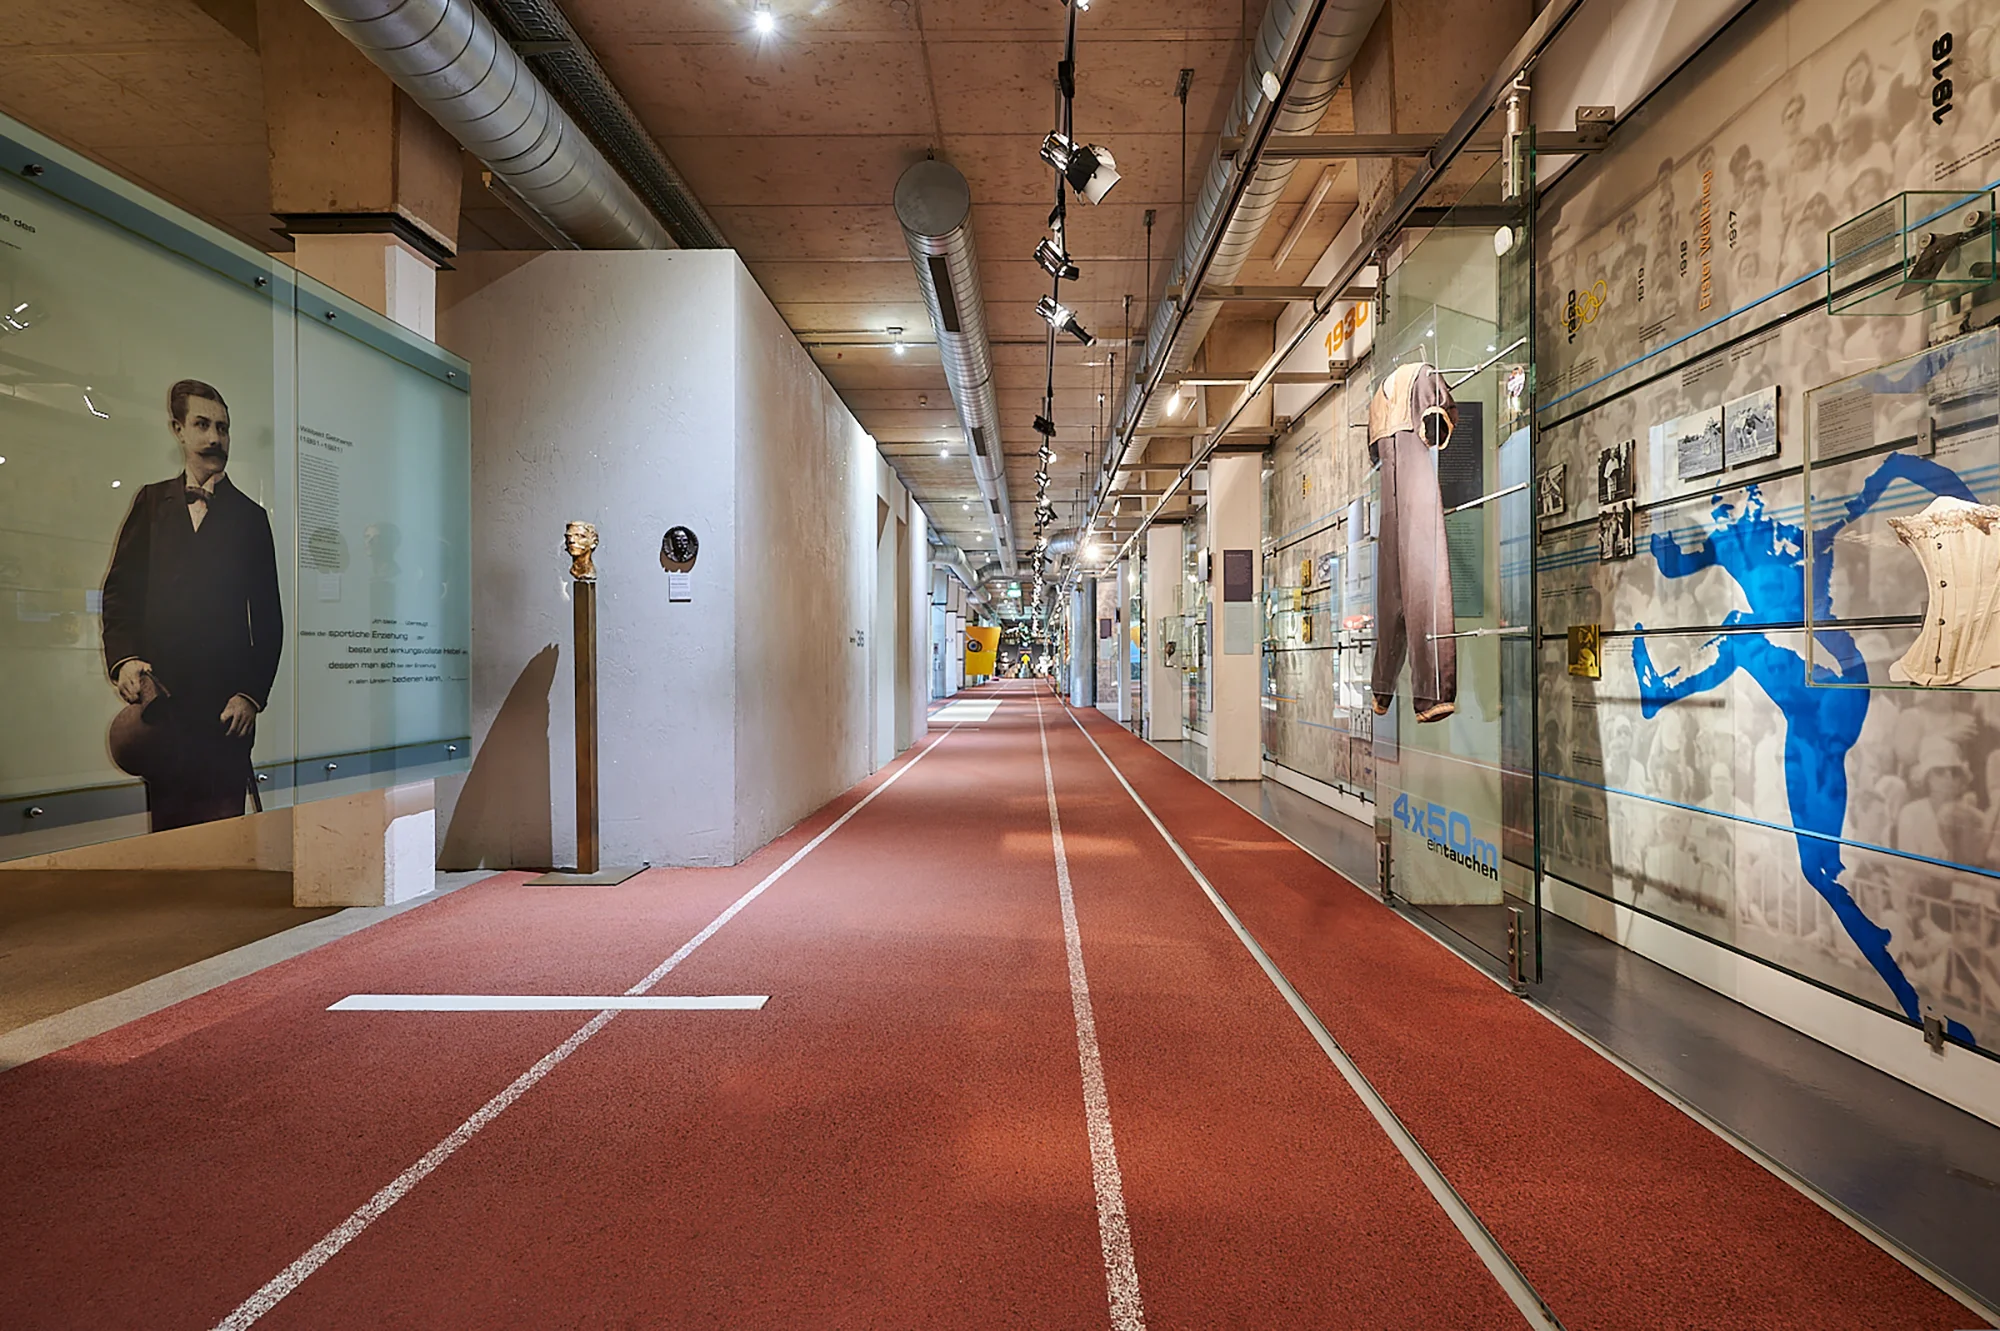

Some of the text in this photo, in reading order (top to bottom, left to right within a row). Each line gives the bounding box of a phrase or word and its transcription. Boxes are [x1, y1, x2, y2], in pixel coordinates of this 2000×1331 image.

[1932, 32, 1953, 126] 1916
[1700, 169, 1713, 311] Erster Weltkrieg
[1728, 210, 1738, 249] 1917
[1324, 301, 1369, 358] 1930
[328, 630, 370, 638] sportliche
[372, 630, 408, 641] Erziehung
[328, 661, 360, 669] dessen
[380, 661, 396, 669] sich
[1393, 792, 1498, 869] 4x50m
[1427, 838, 1499, 881] eintauchen
